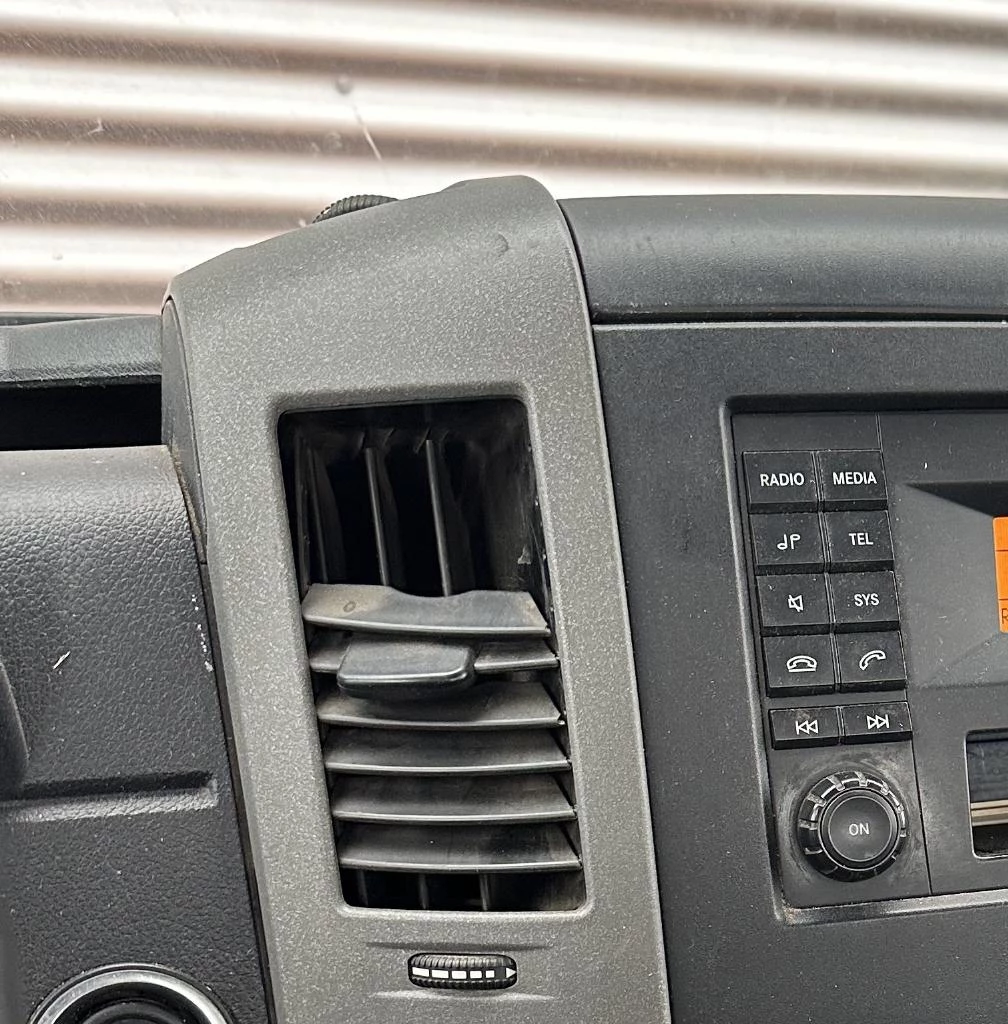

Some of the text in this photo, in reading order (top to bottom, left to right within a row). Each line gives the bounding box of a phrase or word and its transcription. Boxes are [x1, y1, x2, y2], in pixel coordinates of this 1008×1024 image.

[759, 471, 805, 488] RADIO
[832, 471, 878, 487] MEDIA
[848, 532, 875, 548] TEL
[853, 592, 881, 608] SYS
[848, 822, 871, 837] ON
